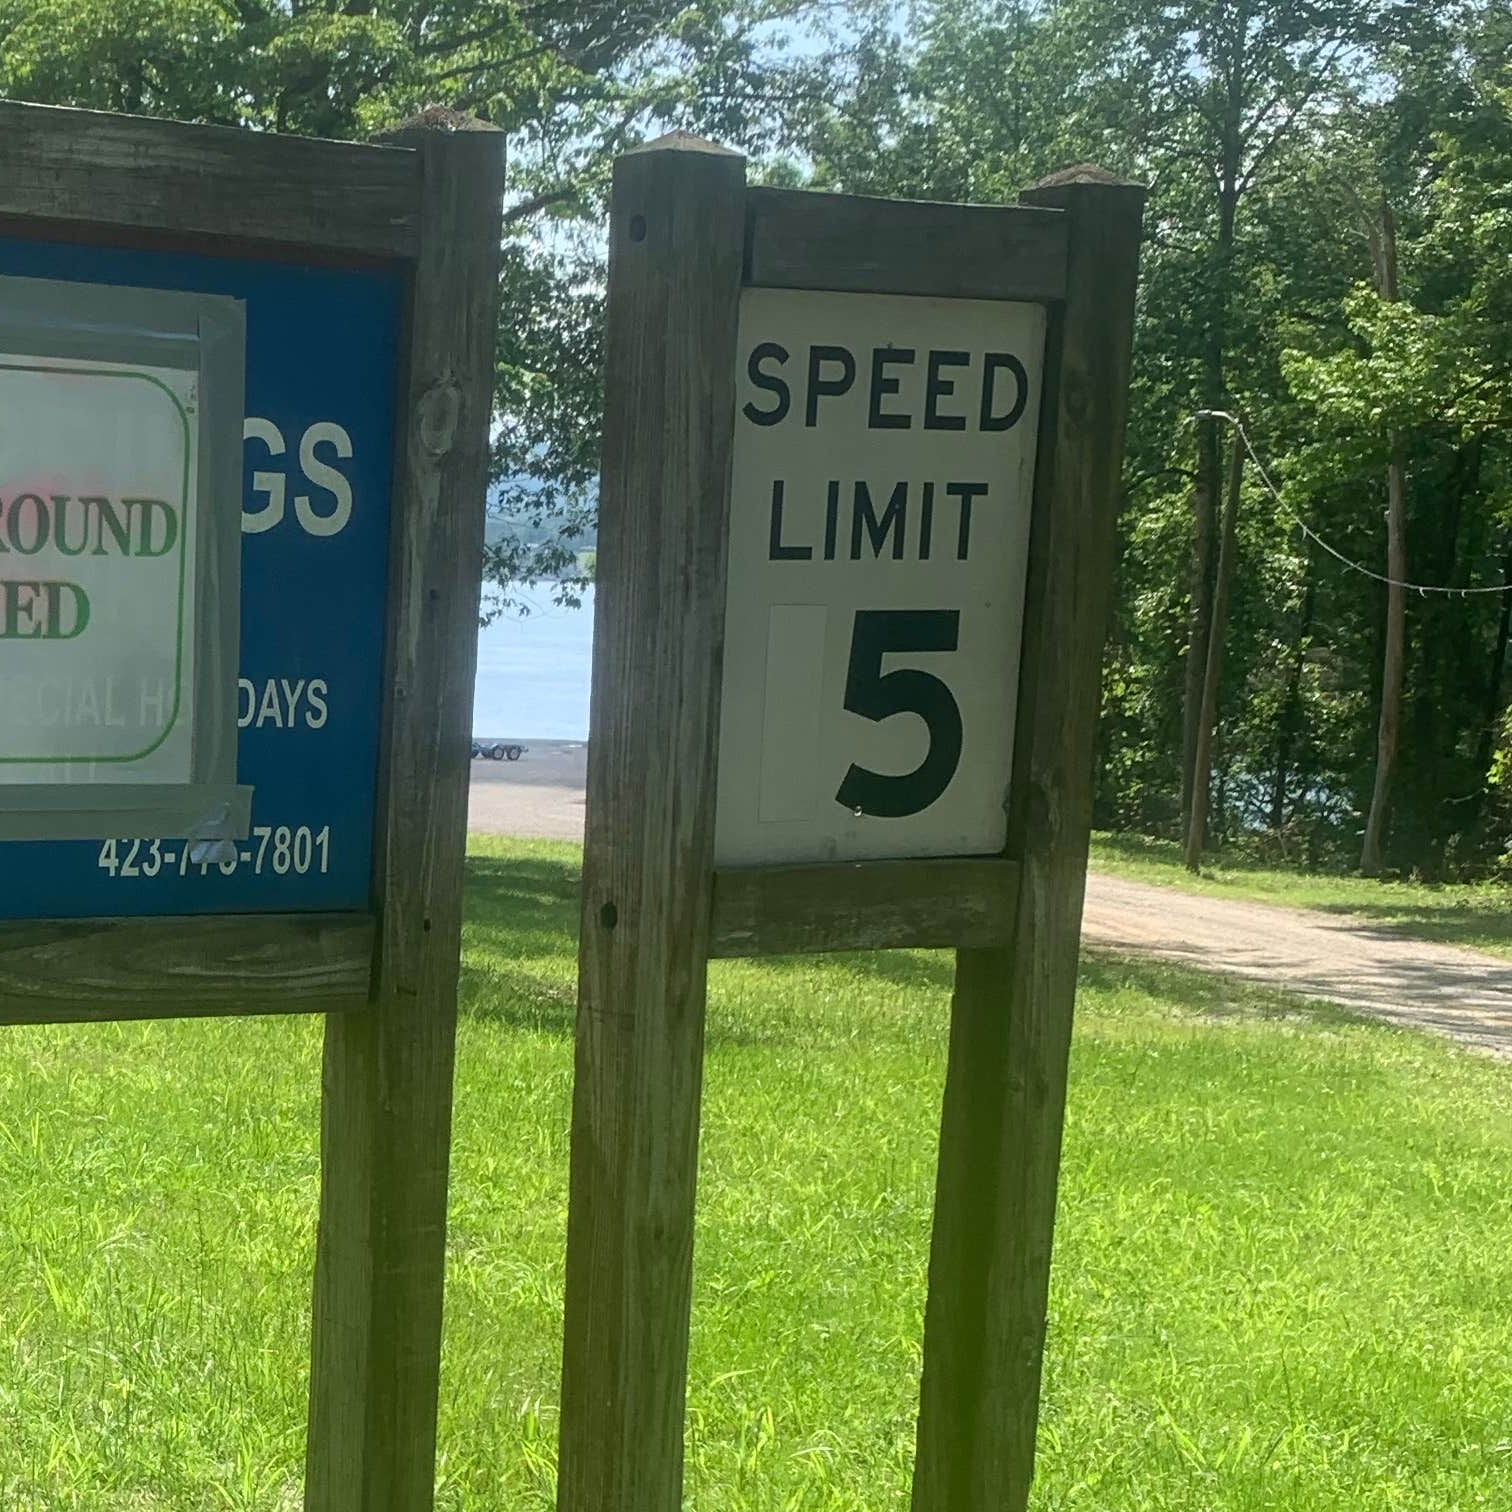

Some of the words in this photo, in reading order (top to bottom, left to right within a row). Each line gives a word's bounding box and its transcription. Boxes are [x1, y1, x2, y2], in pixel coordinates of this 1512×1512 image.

[742, 342, 1029, 432] SPEED
[768, 479, 989, 561] LIMIT
[834, 609, 964, 819] 5
